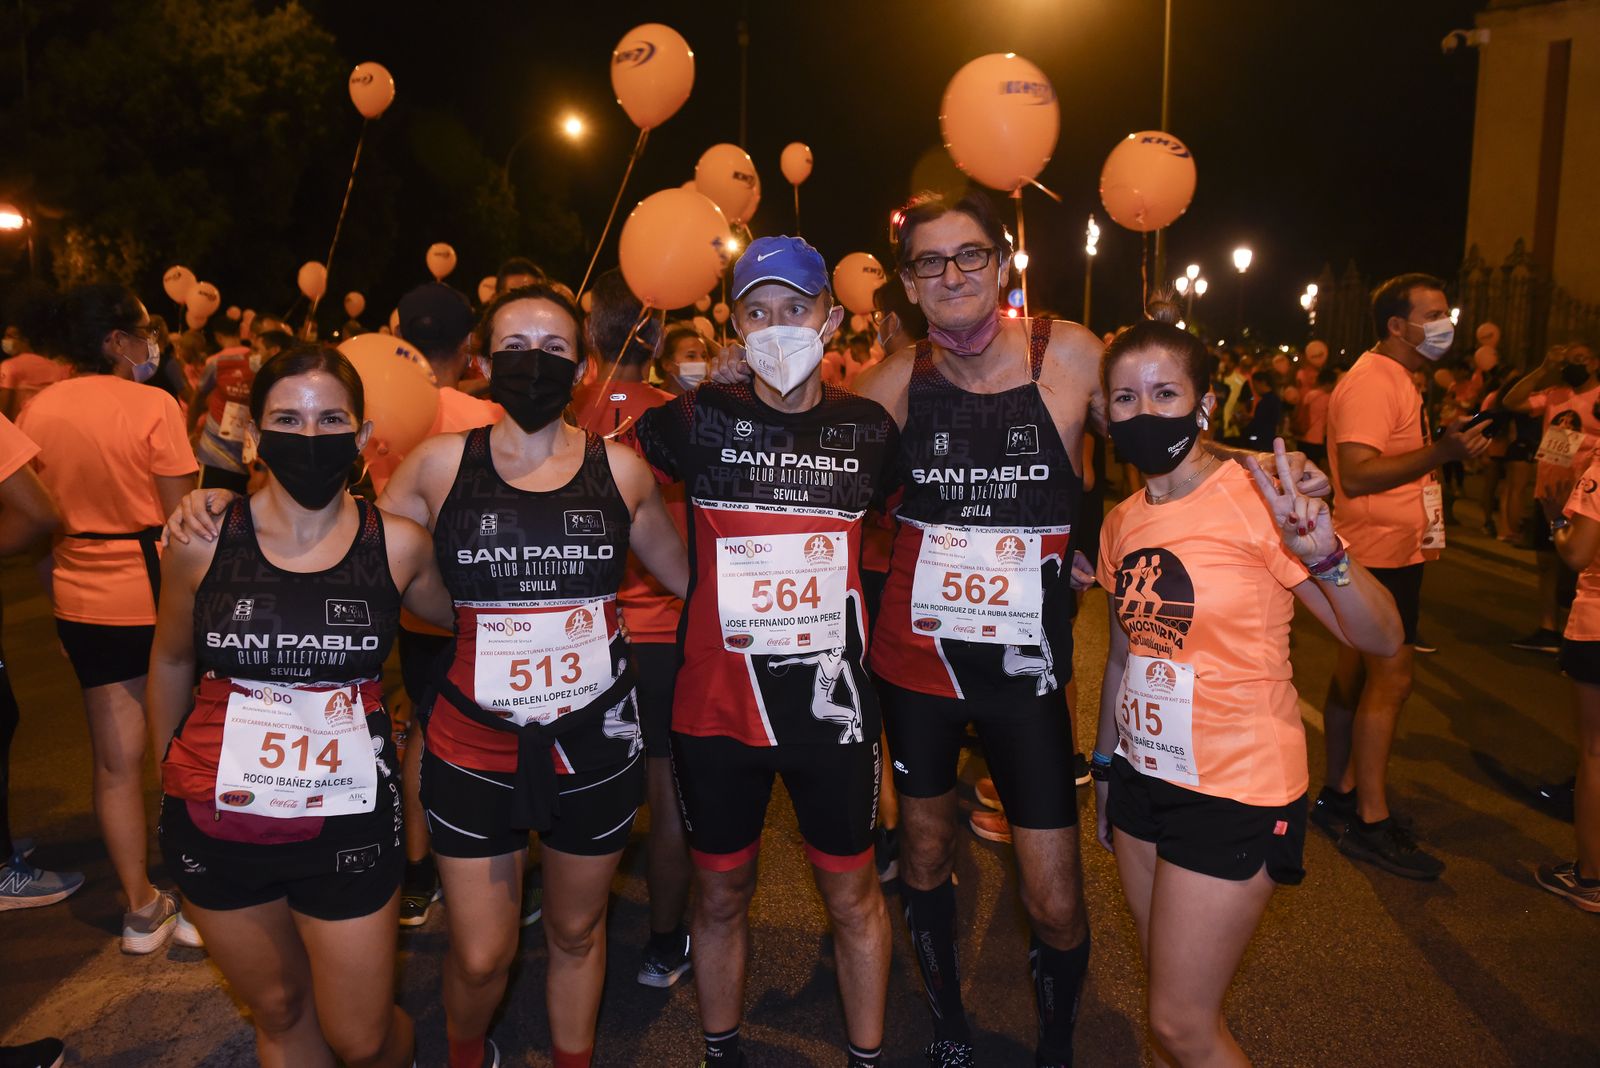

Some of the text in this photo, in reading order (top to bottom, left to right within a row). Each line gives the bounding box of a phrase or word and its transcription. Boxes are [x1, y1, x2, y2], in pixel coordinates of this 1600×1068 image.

[1168, 436, 1189, 452] Reebok
[721, 448, 860, 473] SAN PABLO
[749, 467, 834, 487] CLUB ATLETISMO
[912, 464, 1050, 484] SAN PABLO
[773, 488, 809, 502] SEVILLA
[939, 484, 964, 501] CLUB
[722, 502, 749, 510] RUNNING
[755, 505, 788, 513] TRIATLÓN
[457, 545, 614, 565] SAN PABLO
[490, 560, 585, 578] CLUB ATLETISMO
[519, 580, 557, 592] SEVILLA
[752, 576, 821, 613] 564
[942, 571, 1009, 606] 562
[725, 612, 841, 628] JOSE FERNANDO MOYA PEREZ
[930, 604, 967, 614] RODRIGUEZ
[1008, 611, 1040, 619] SANCHEZ
[206, 632, 379, 651] SAN PABLO
[1128, 620, 1184, 650] NOCTURNA
[238, 650, 347, 666] CLUB ATLETISMO
[270, 667, 312, 677] SEVILLA
[509, 652, 582, 692] 513
[492, 683, 598, 707] ANA BELEN LOPEZ LOPEZ
[259, 732, 342, 773] 514
[1156, 742, 1185, 756] SALCES
[243, 773, 353, 788] ROCIO IBAÑEZ SALCES
[223, 791, 249, 804] KH7
